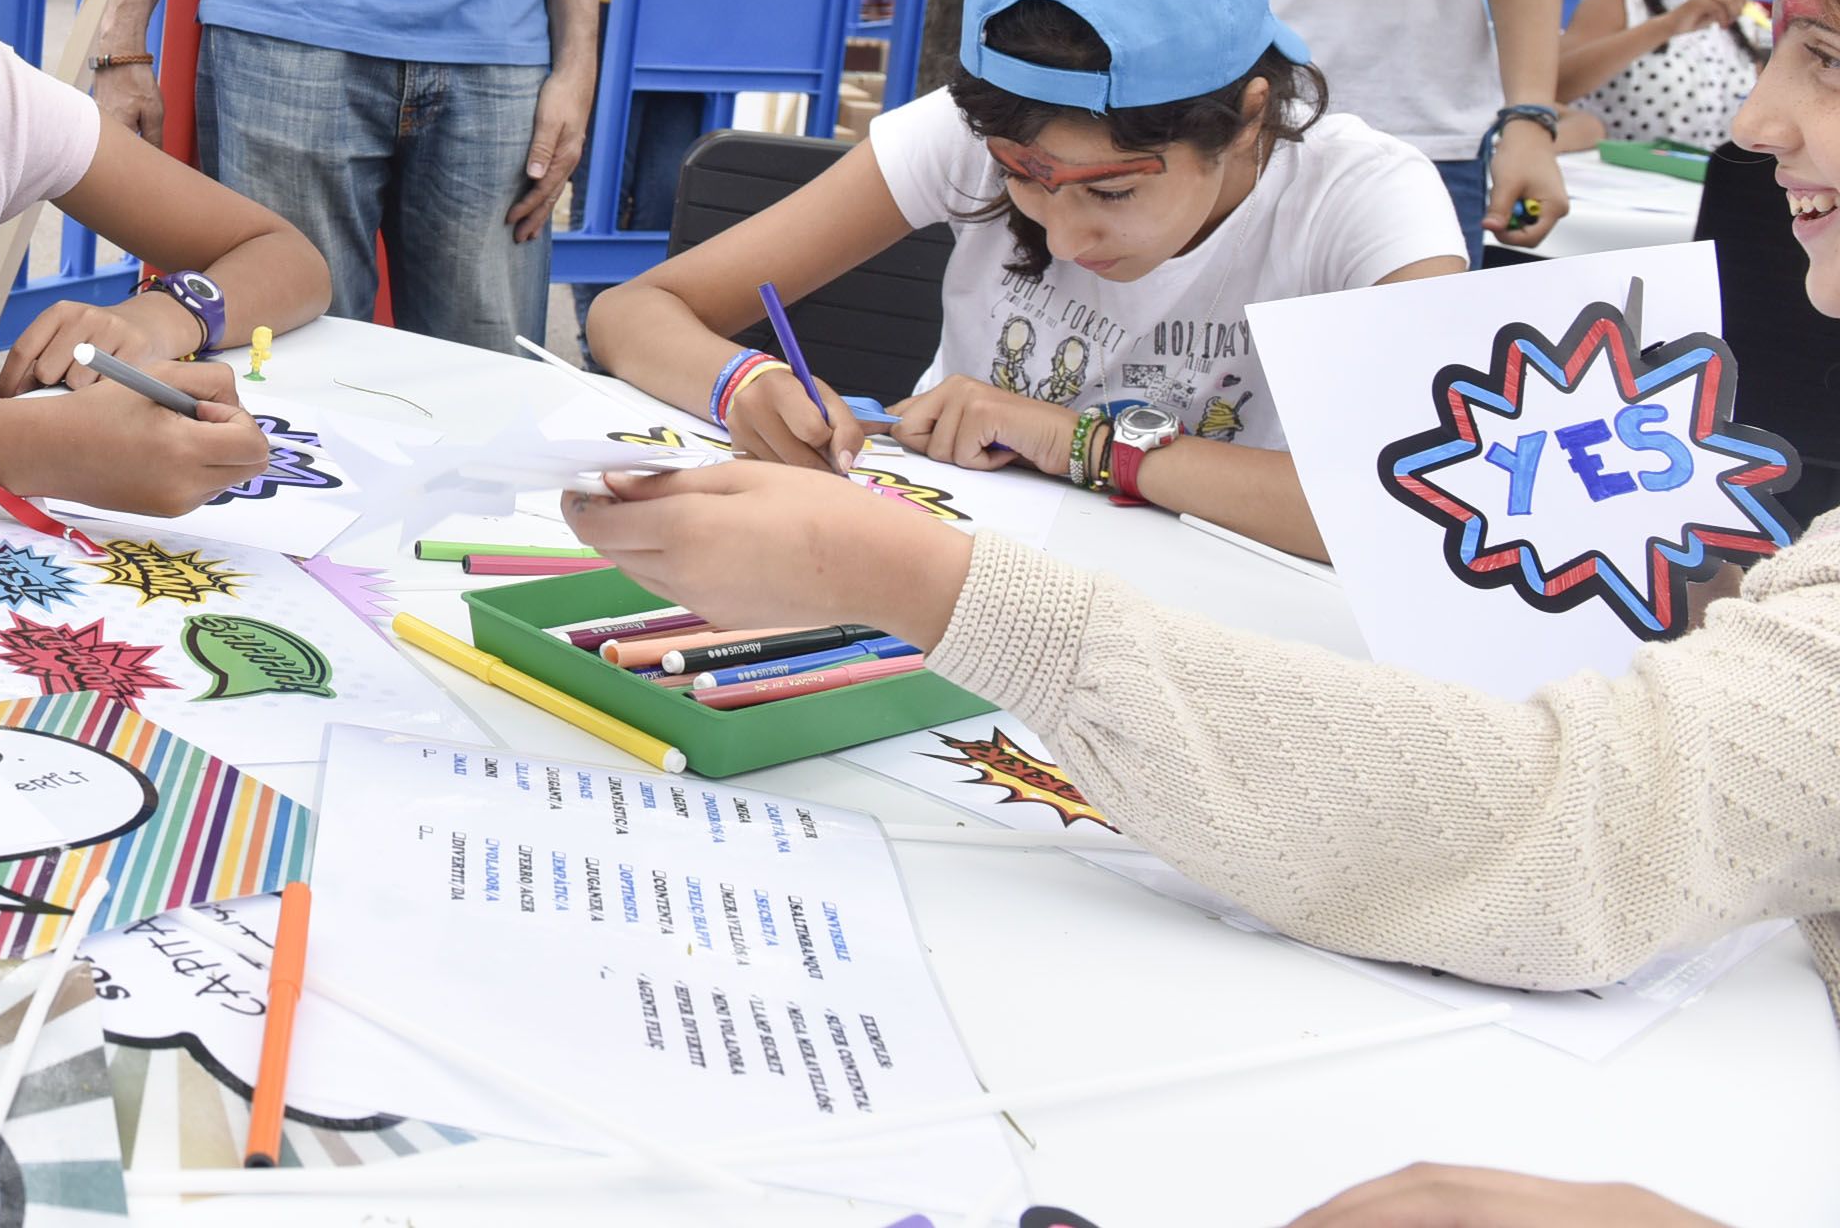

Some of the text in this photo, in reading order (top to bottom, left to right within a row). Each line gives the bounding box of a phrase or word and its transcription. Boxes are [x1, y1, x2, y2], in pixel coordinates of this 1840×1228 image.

[1060, 299, 1126, 353] FORGET
[1484, 403, 1695, 516] YES
[110, 539, 202, 604] WHAM!
[727, 641, 762, 657] Abacus
[756, 664, 790, 678] Abacus
[454, 756, 467, 775] MAXI
[485, 761, 498, 778] MINI
[578, 776, 594, 800] SPACE
[547, 771, 563, 810] GEGANT/A
[641, 786, 657, 809] HIPER
[672, 792, 689, 819] AGENT
[736, 803, 752, 824] MEGA
[450, 838, 465, 901] DIVERTIT/DA
[483, 845, 500, 902] VOLADOR/A
[516, 852, 535, 913] FERRO/ACER
[587, 864, 604, 922] JUGANER/A
[620, 871, 639, 923] OPTIMISTA
[654, 877, 675, 935] CONTENT/A
[756, 897, 779, 947] SECRET/A
[792, 903, 824, 980] SALTIMBANQUI
[825, 908, 851, 962] INVISIBLE
[637, 978, 659, 1019] AGENTE
[674, 985, 695, 1016] HIPER
[760, 1034, 786, 1076] SECRET
